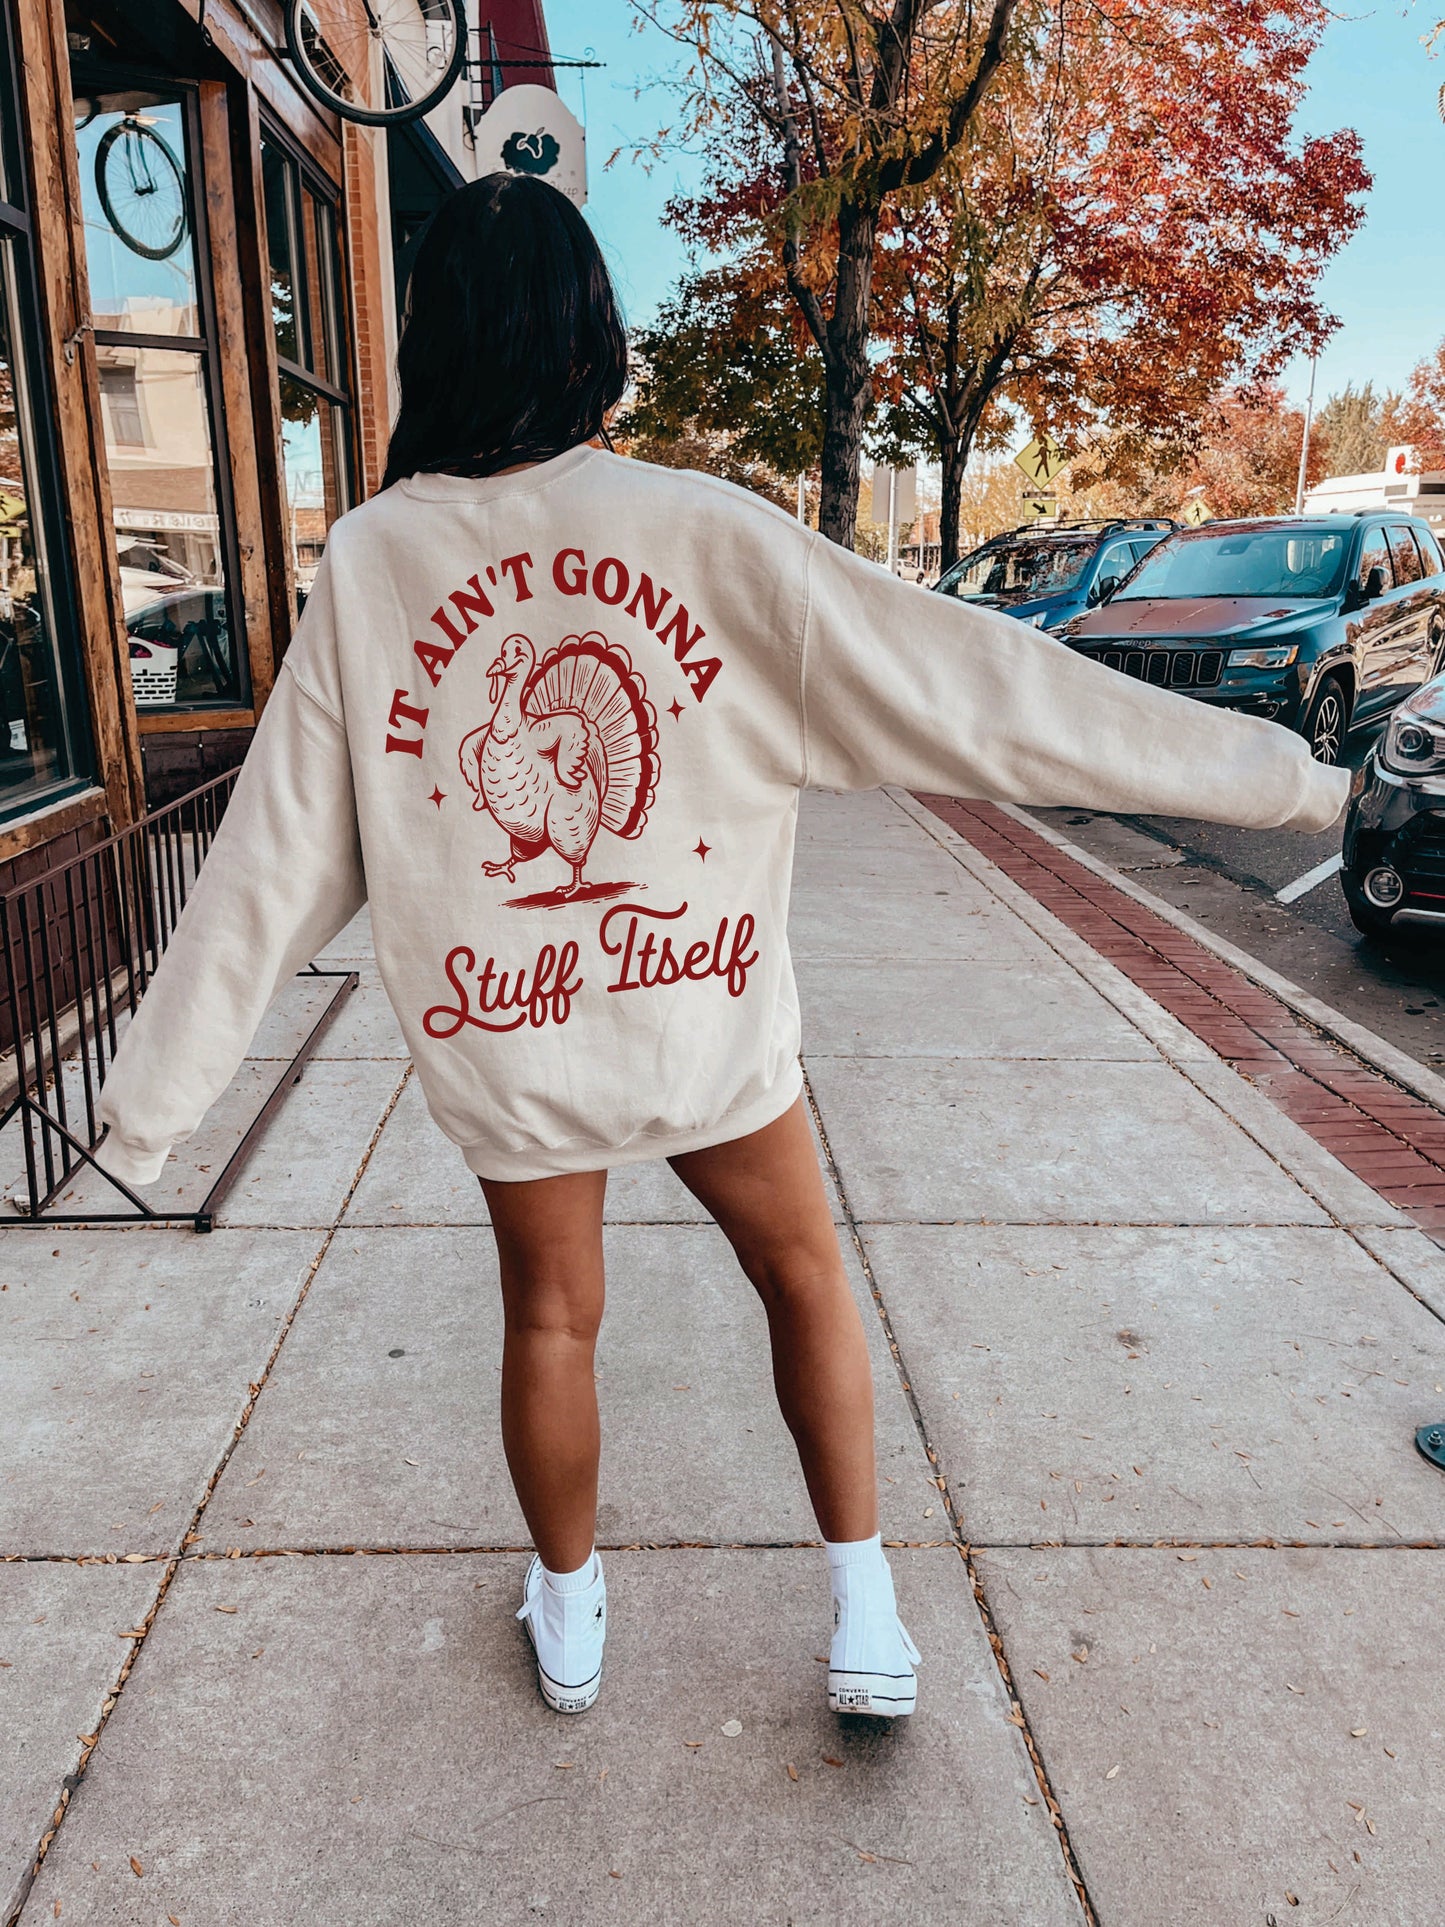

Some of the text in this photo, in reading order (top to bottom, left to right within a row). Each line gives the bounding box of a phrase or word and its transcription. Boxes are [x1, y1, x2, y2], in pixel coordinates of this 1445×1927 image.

[385, 547, 723, 759] IT AIN'T GONNA
[422, 901, 759, 1039] Stuff Itself
